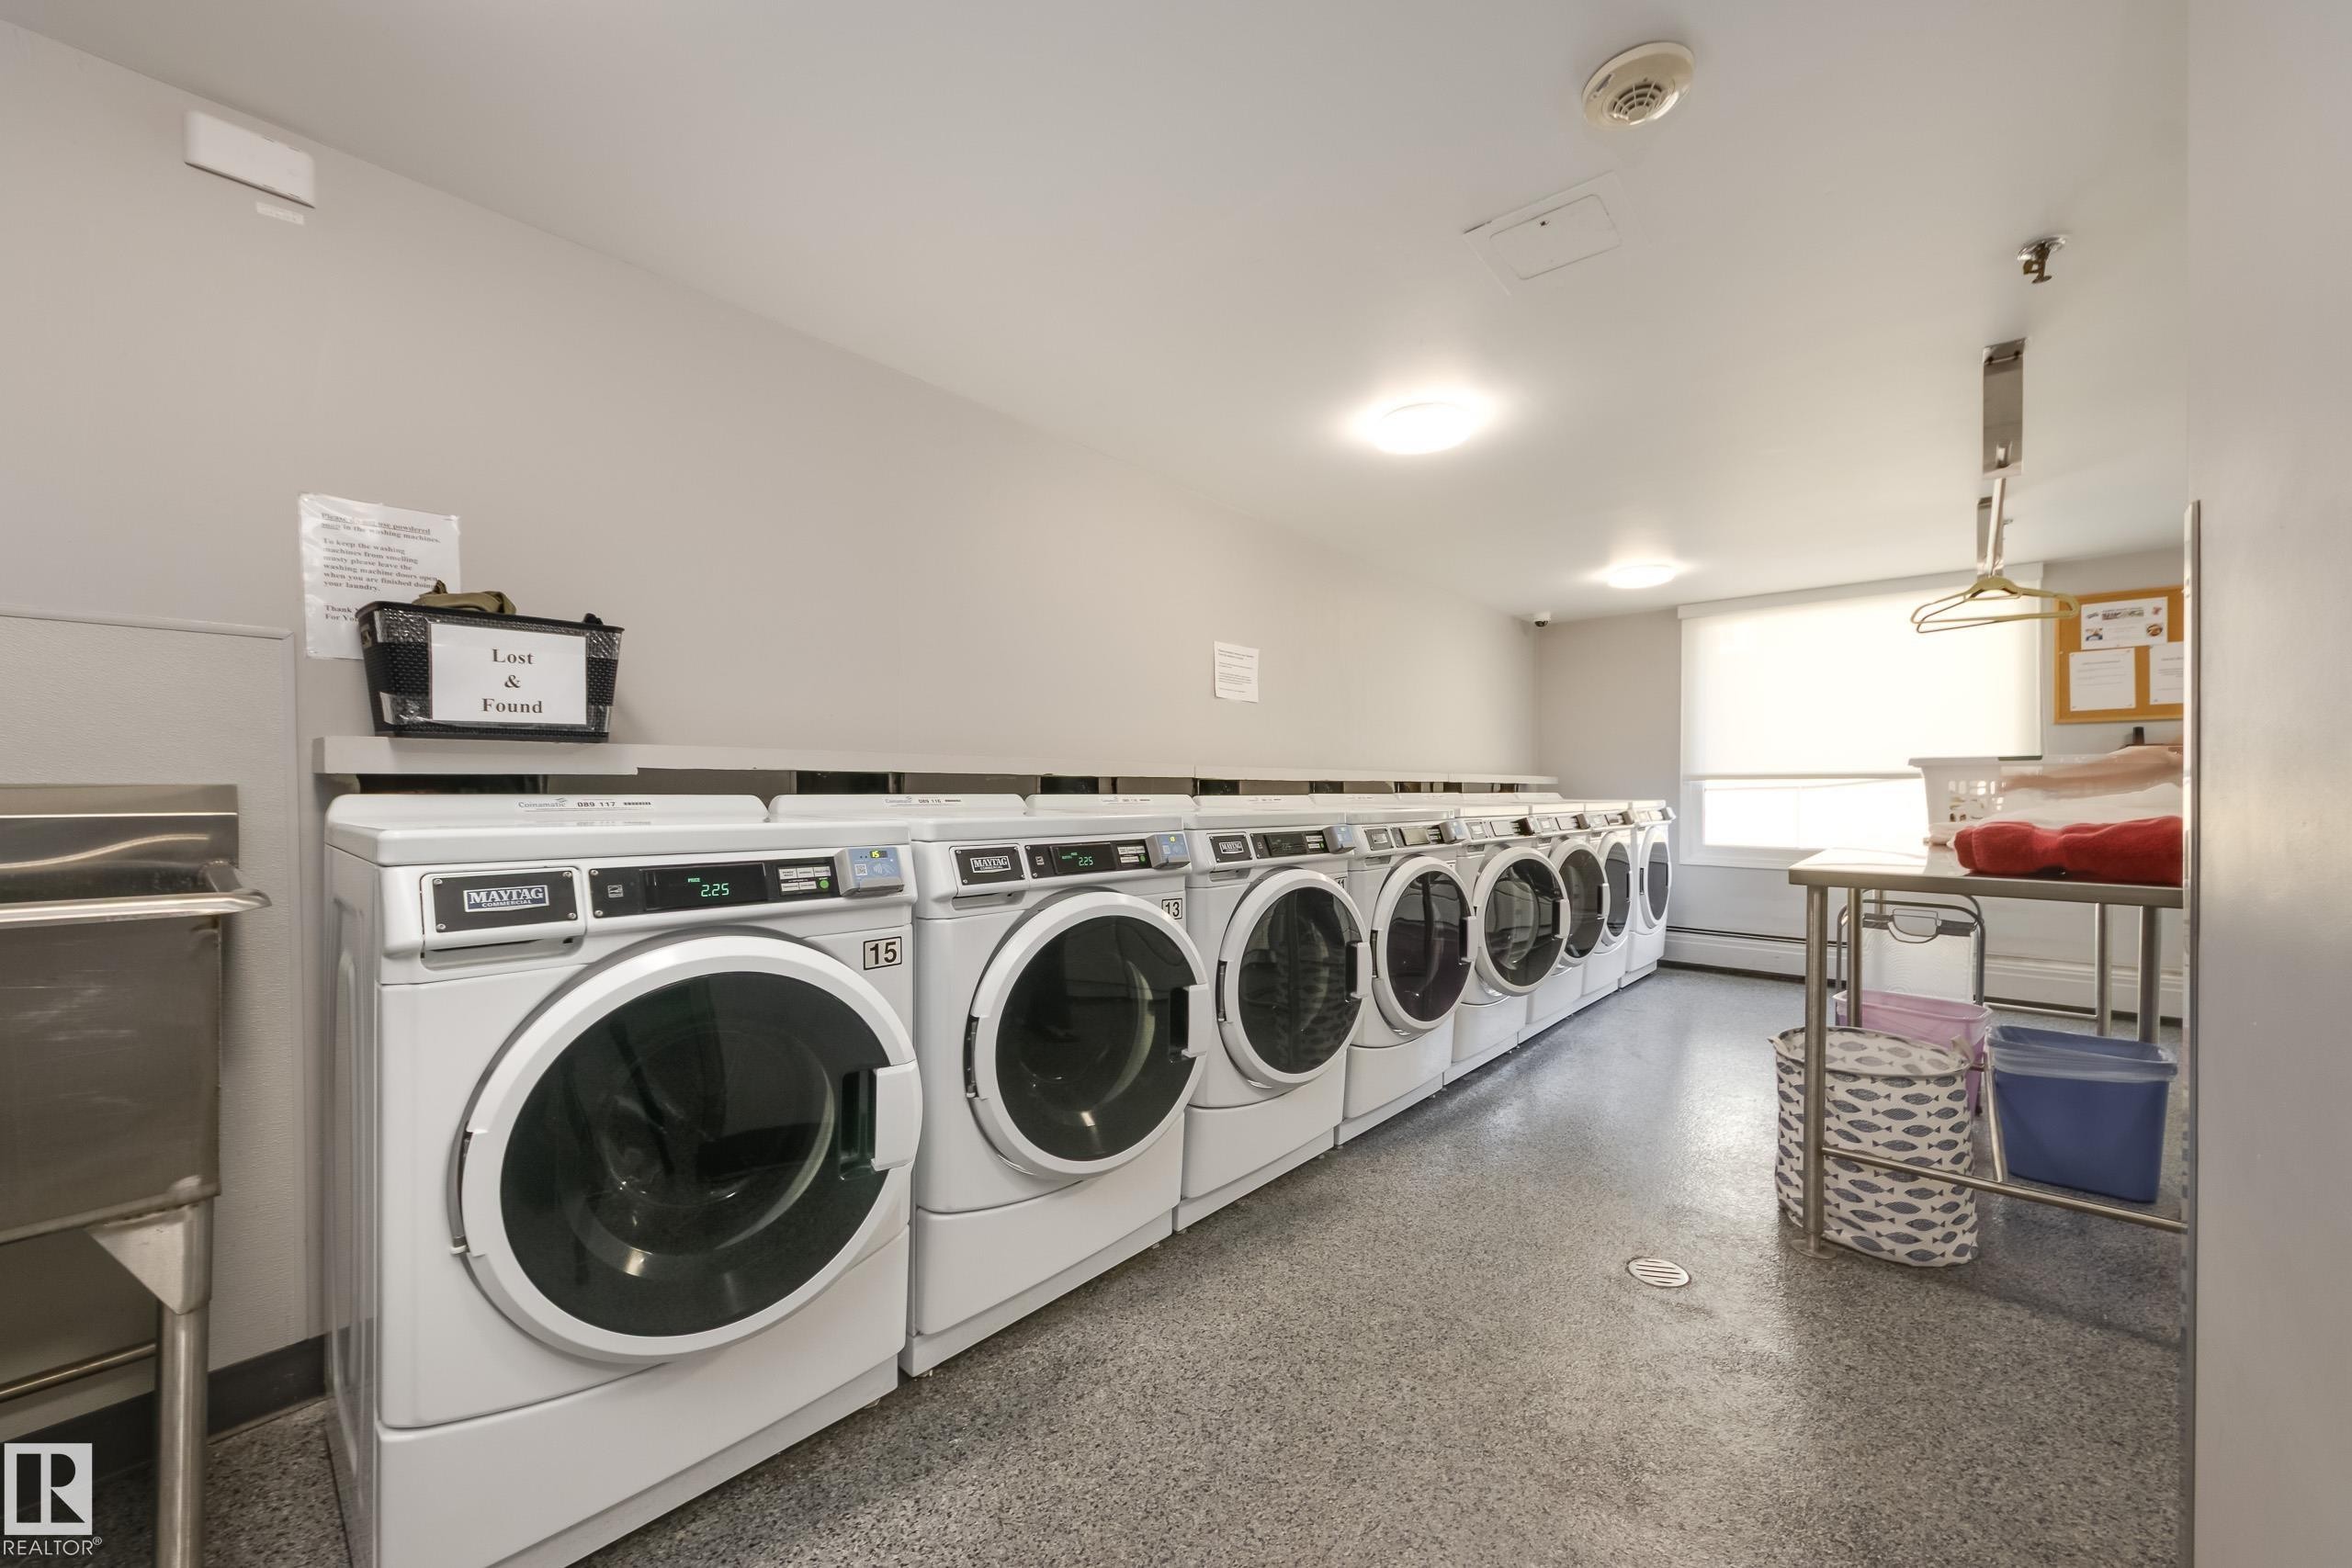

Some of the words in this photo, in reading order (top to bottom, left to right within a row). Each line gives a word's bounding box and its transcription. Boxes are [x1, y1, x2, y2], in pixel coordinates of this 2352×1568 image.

[492, 648, 535, 665] Lost
[503, 674, 521, 689] &
[481, 697, 543, 714] Found
[973, 857, 1008, 868] MAYTAG
[469, 887, 544, 904] MAYTAG
[701, 883, 729, 897] 2.25
[481, 899, 532, 908] COMMERCIAL
[1165, 901, 1180, 918] 13
[870, 941, 898, 964] 15
